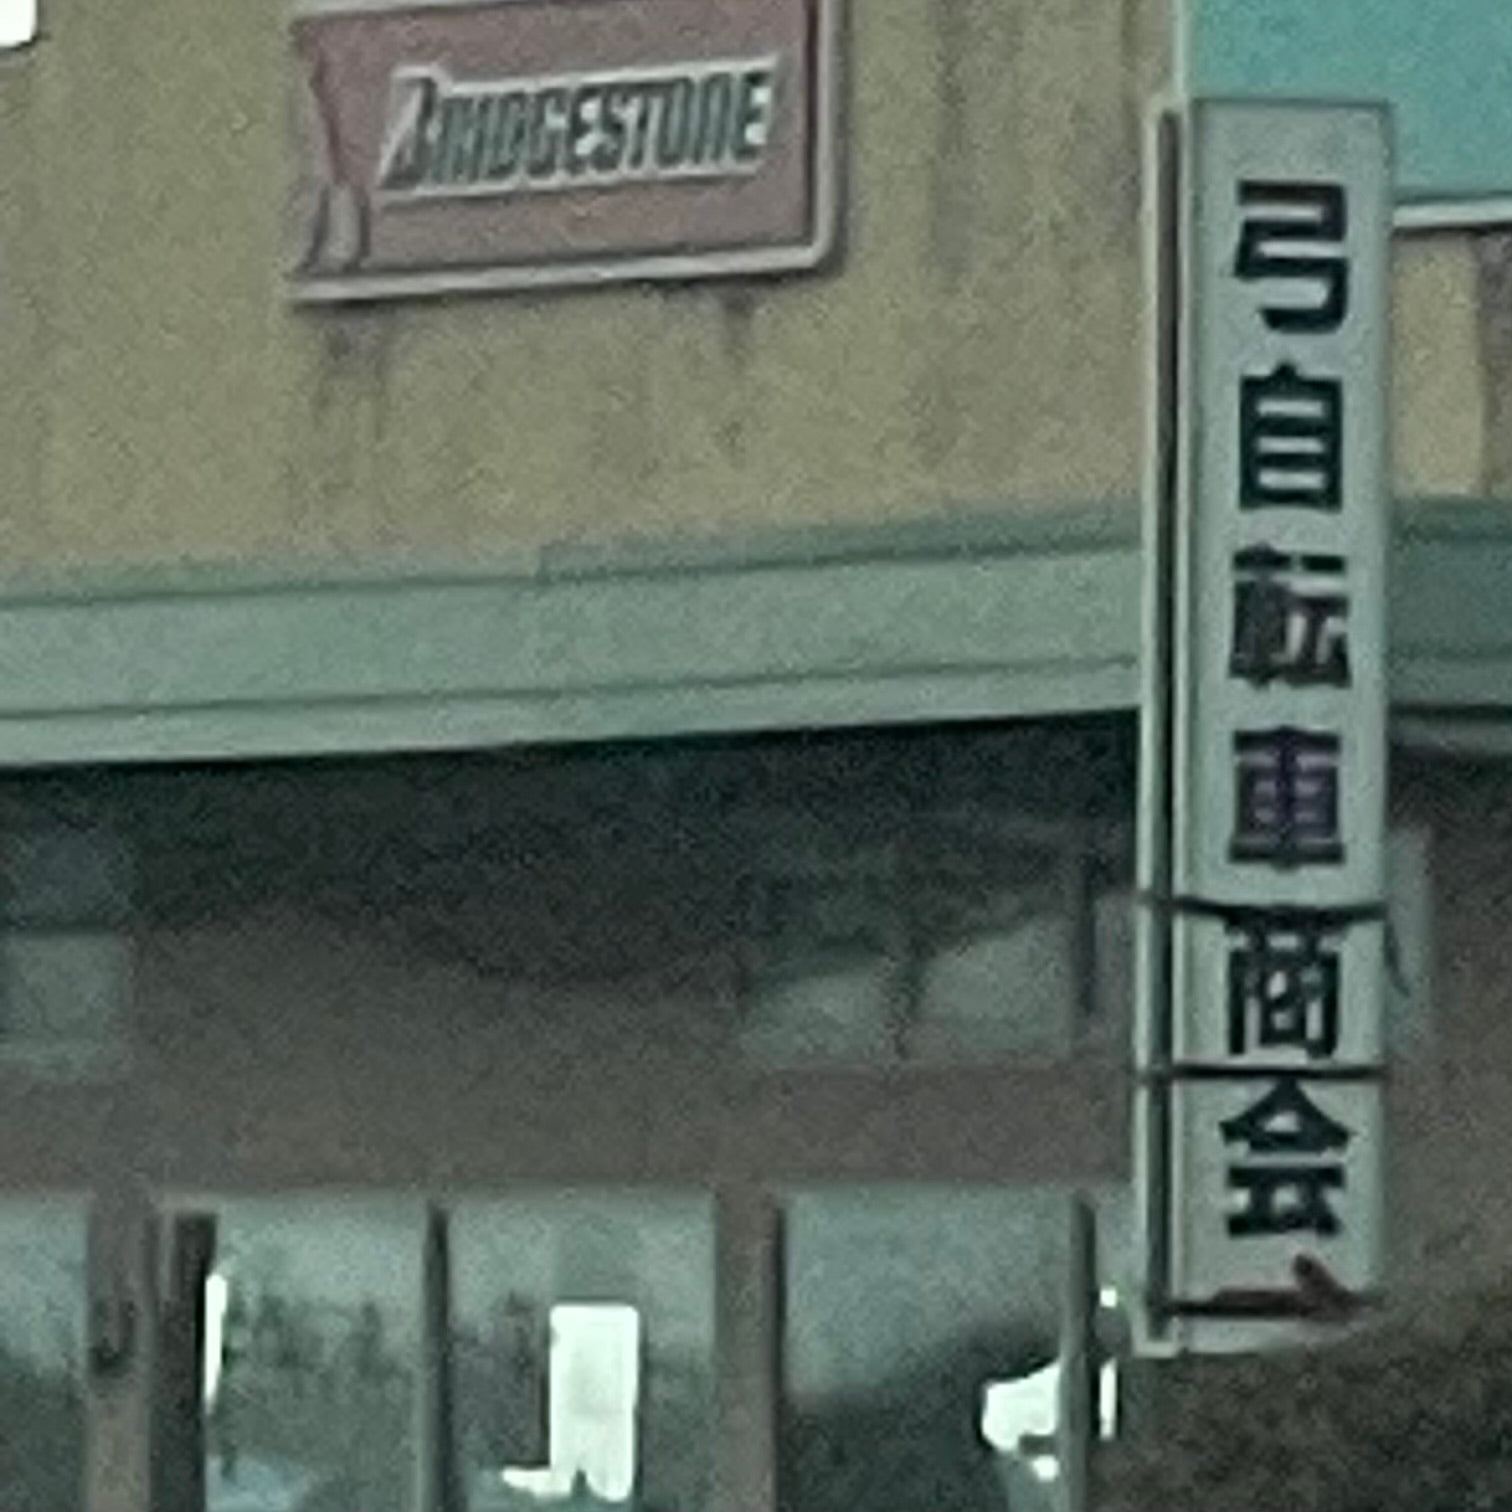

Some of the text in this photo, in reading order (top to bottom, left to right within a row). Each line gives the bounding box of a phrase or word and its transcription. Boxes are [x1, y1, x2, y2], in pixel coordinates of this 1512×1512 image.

[379, 55, 778, 196] BRIDGESTONE
[1220, 179, 1354, 1239] 弓自転車商会
